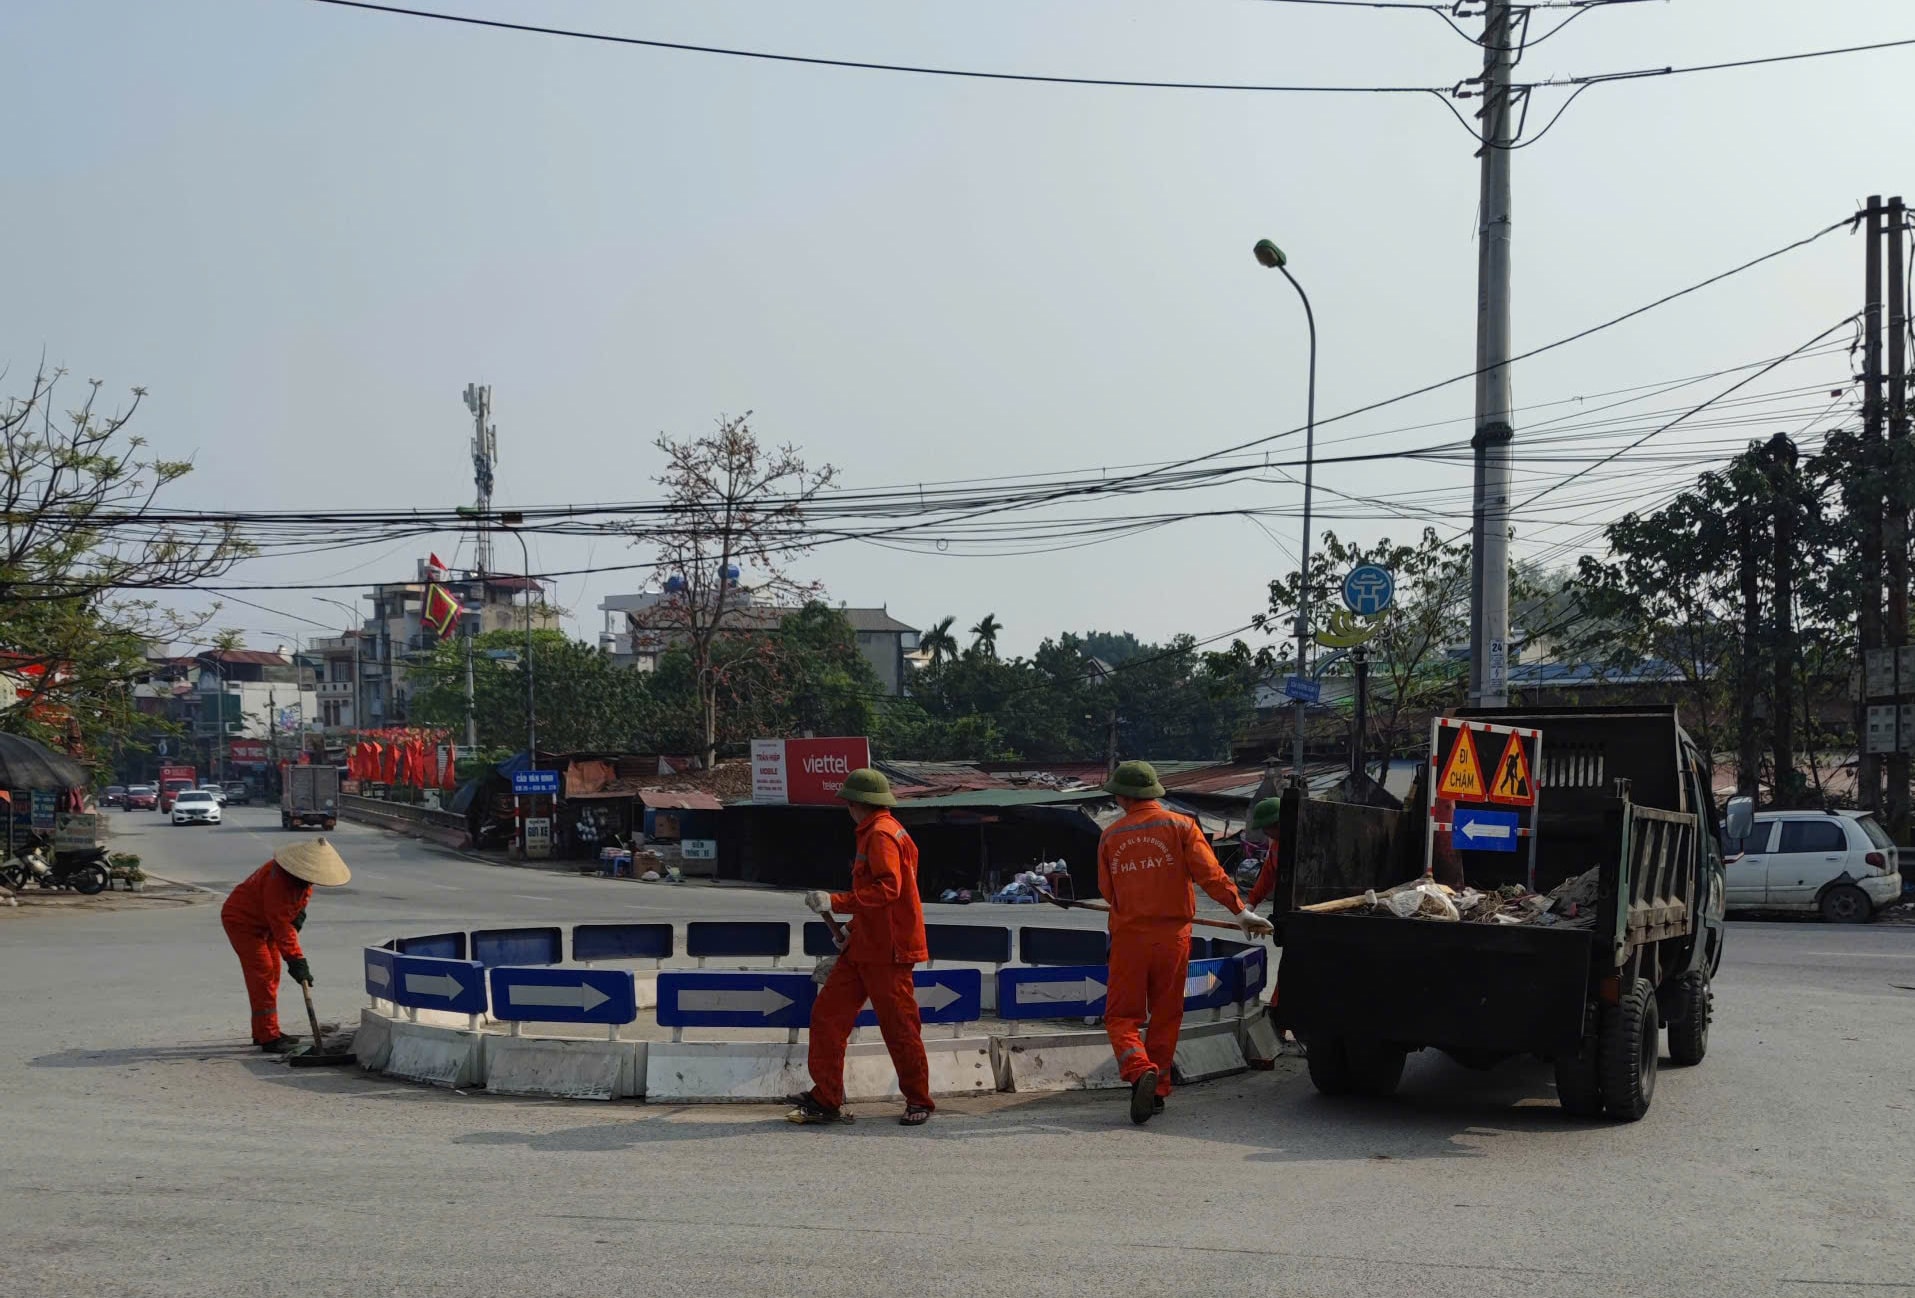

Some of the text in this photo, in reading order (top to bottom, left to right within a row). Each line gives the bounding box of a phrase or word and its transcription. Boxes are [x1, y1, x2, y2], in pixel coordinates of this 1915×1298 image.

[803, 754, 849, 773] viettel
[1459, 748, 1469, 764] ĐI
[822, 780, 844, 791] teleco
[1121, 856, 1163, 873] HÀ TÂY
